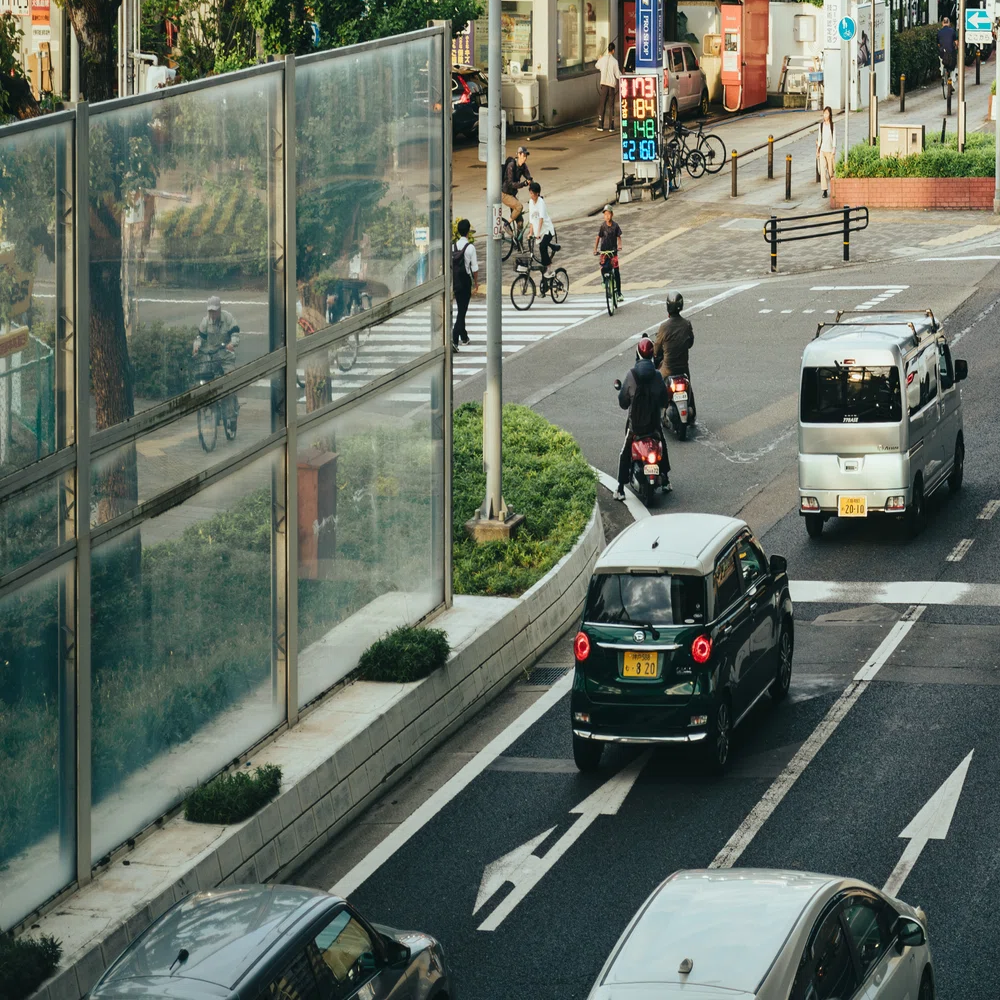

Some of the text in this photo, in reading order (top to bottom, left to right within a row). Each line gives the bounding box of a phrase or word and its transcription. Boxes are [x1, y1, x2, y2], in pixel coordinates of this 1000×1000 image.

[632, 77, 655, 98] 173
[632, 98, 655, 119] 184
[633, 118, 655, 139] 148
[628, 140, 656, 160] 2160
[495, 217, 501, 226] 3
[845, 504, 865, 514] 20-10
